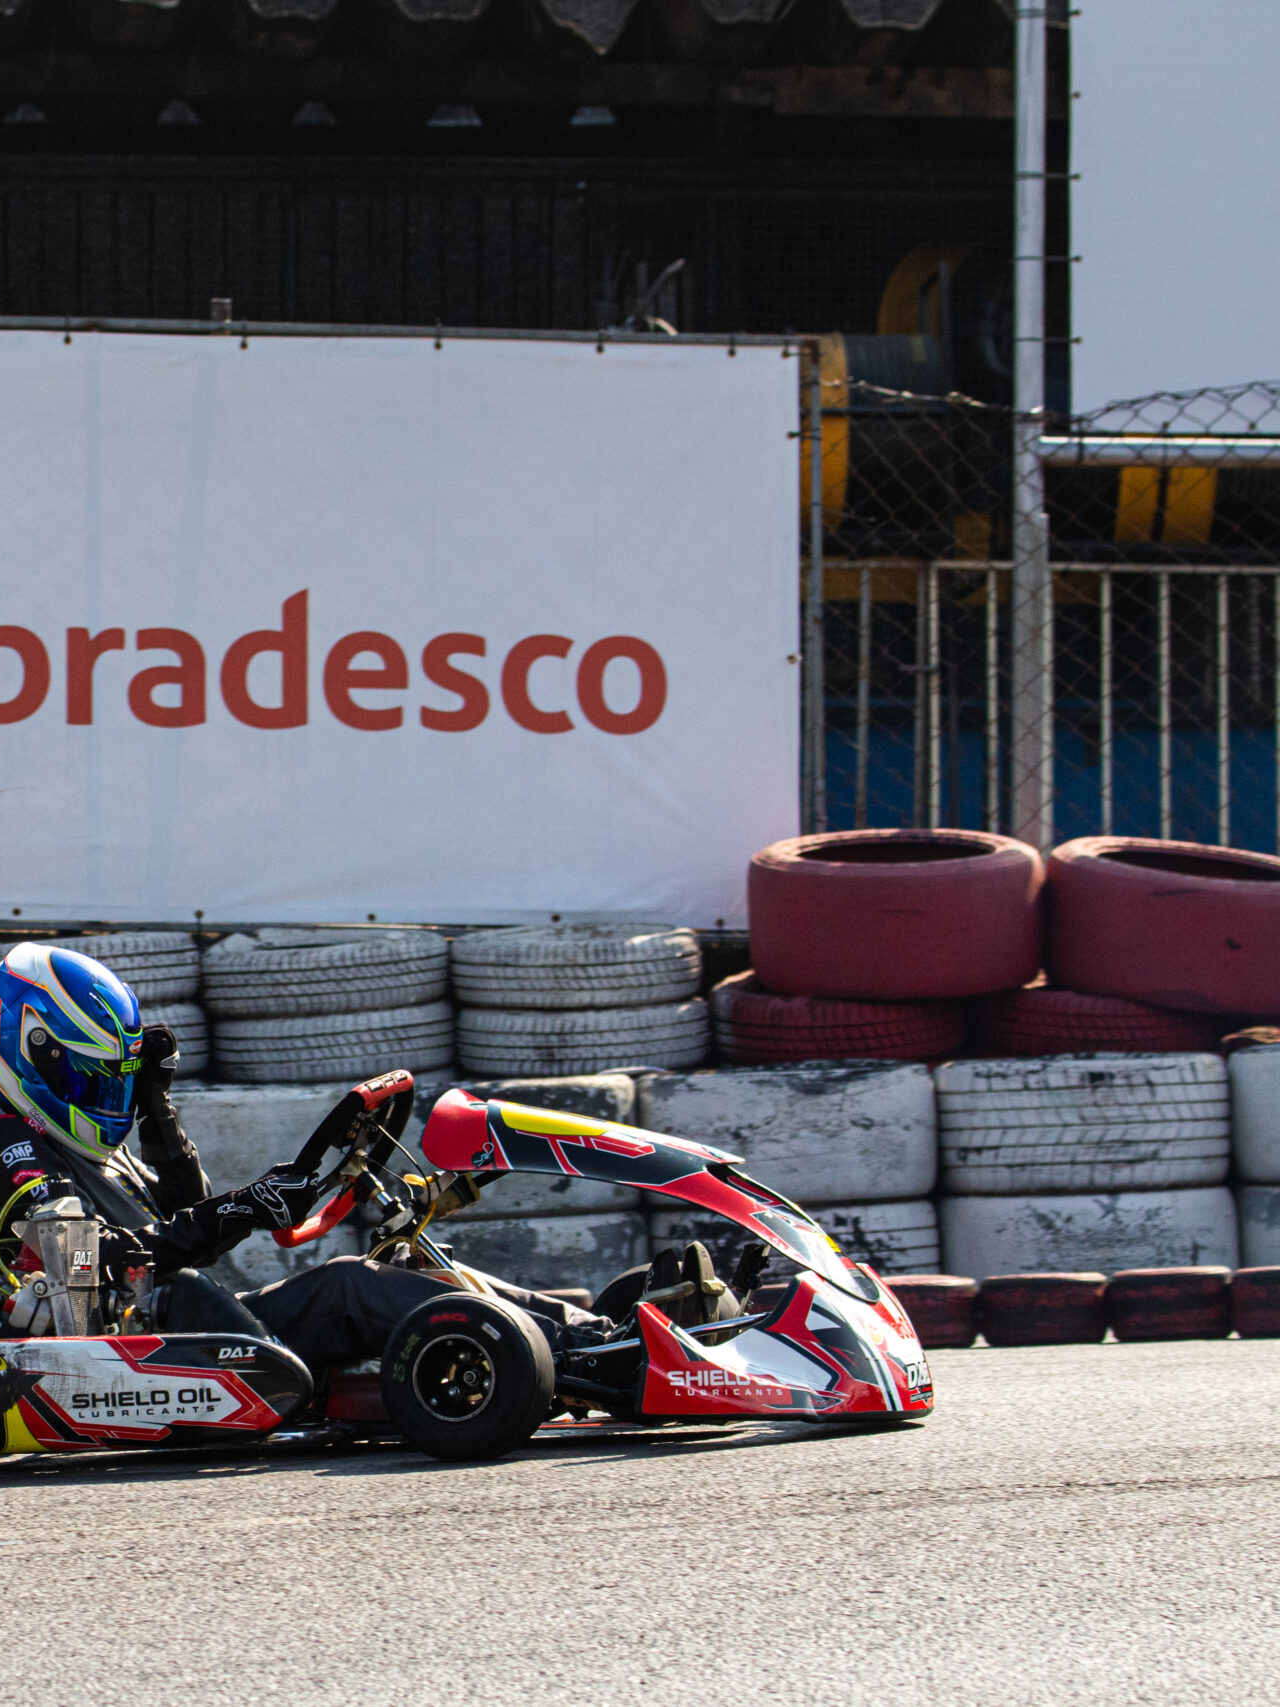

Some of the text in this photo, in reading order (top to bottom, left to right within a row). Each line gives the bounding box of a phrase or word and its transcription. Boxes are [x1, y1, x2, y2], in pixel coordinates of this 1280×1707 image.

[2, 1144, 34, 1164] OMP
[73, 1250, 93, 1266] DAI
[217, 1346, 257, 1360] DAI
[667, 1370, 751, 1386] SHIELD
[72, 1387, 222, 1409] SHIELD OIL
[674, 1388, 783, 1396] LUBRICANTS
[78, 1406, 216, 1419] LUBRICANTS
